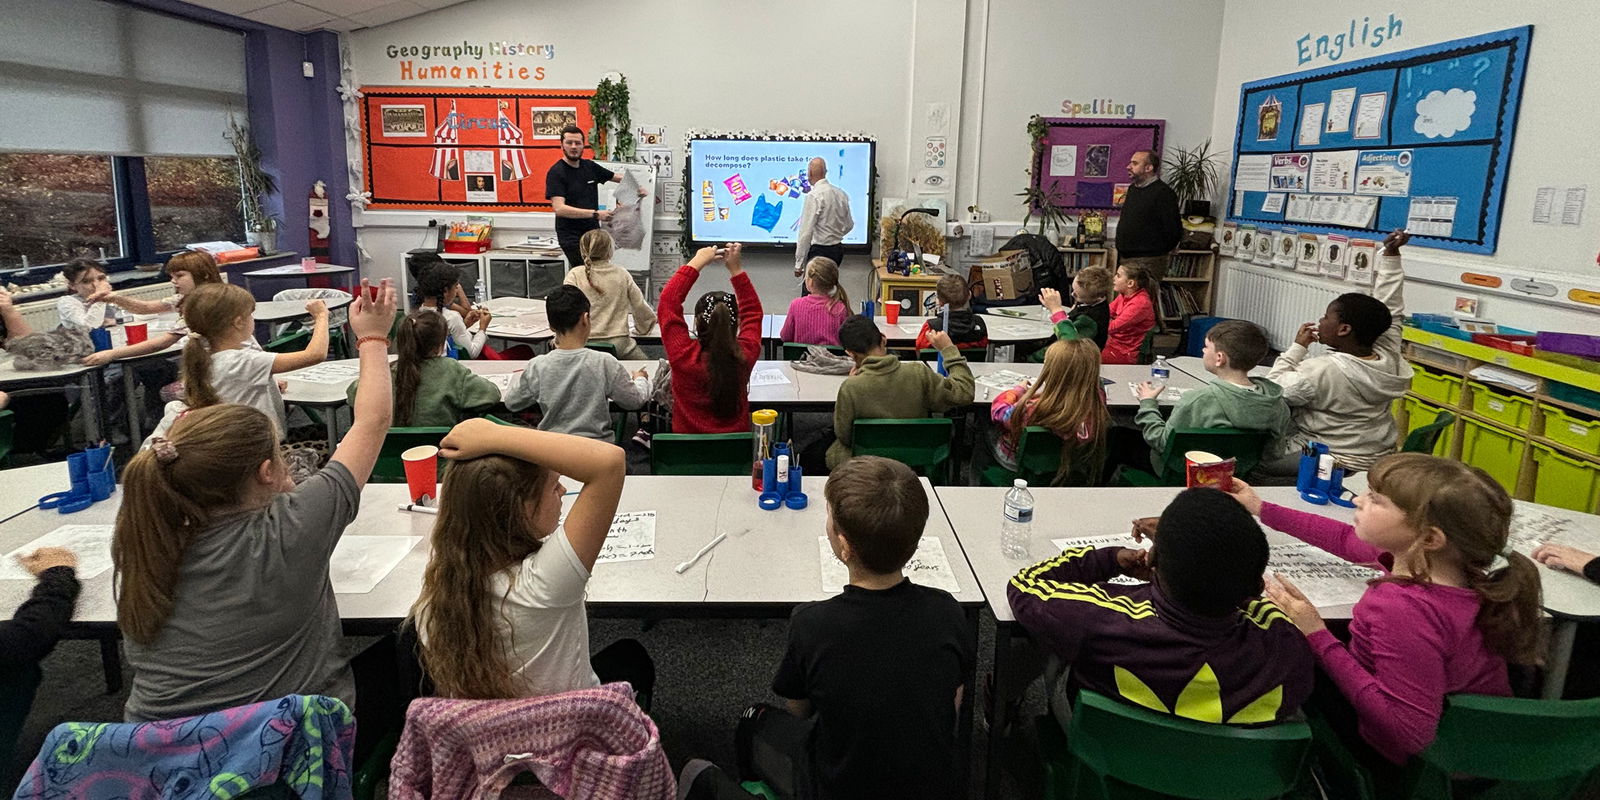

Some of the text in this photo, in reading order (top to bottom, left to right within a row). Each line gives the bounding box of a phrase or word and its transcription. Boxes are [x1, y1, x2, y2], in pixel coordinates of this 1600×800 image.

[1296, 13, 1403, 66] English
[386, 40, 554, 60] Geography History
[400, 60, 546, 81] Humanities
[1061, 98, 1136, 120] Spelling
[447, 112, 509, 130] Circus
[761, 155, 785, 163] plastic
[1274, 156, 1293, 166] Verbs
[1361, 153, 1397, 164] Adjectives
[913, 564, 940, 572] years
